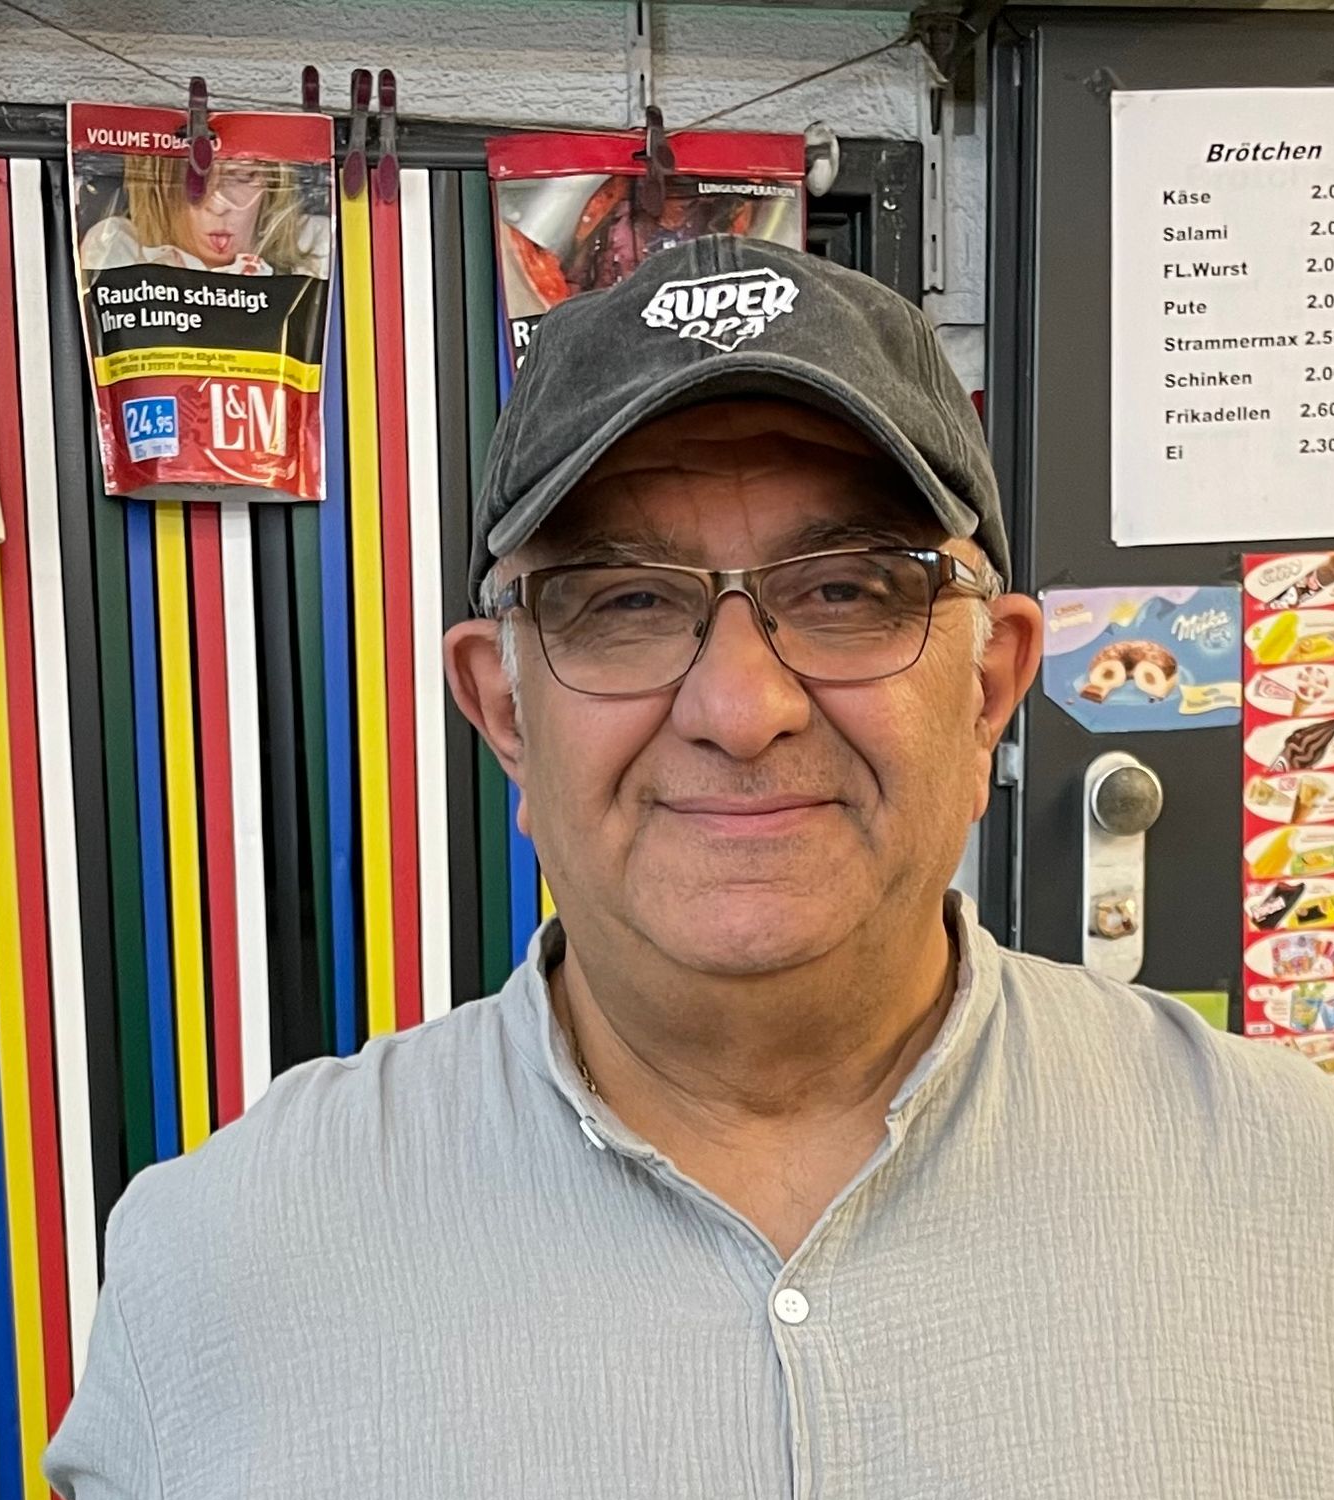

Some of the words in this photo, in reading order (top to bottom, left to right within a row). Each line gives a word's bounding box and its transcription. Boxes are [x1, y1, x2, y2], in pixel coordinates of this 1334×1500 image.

[87, 128, 150, 148] VOLUME
[1206, 141, 1322, 164] Brötchen
[1163, 189, 1211, 206] Käse
[1163, 225, 1228, 241] Salami
[1163, 262, 1247, 278] FL.Wurst
[97, 281, 179, 305] Rauchen
[184, 287, 268, 313] schädigt
[643, 277, 796, 329] SUPER
[1164, 300, 1207, 316] Pute
[101, 311, 136, 332] Ihre
[141, 310, 202, 333] Lunge
[679, 316, 765, 338] OPA
[1164, 333, 1298, 352] Strammermax
[1165, 370, 1252, 388] Schinken
[1165, 406, 1270, 424] Frikadellen
[1167, 445, 1183, 460] Ei
